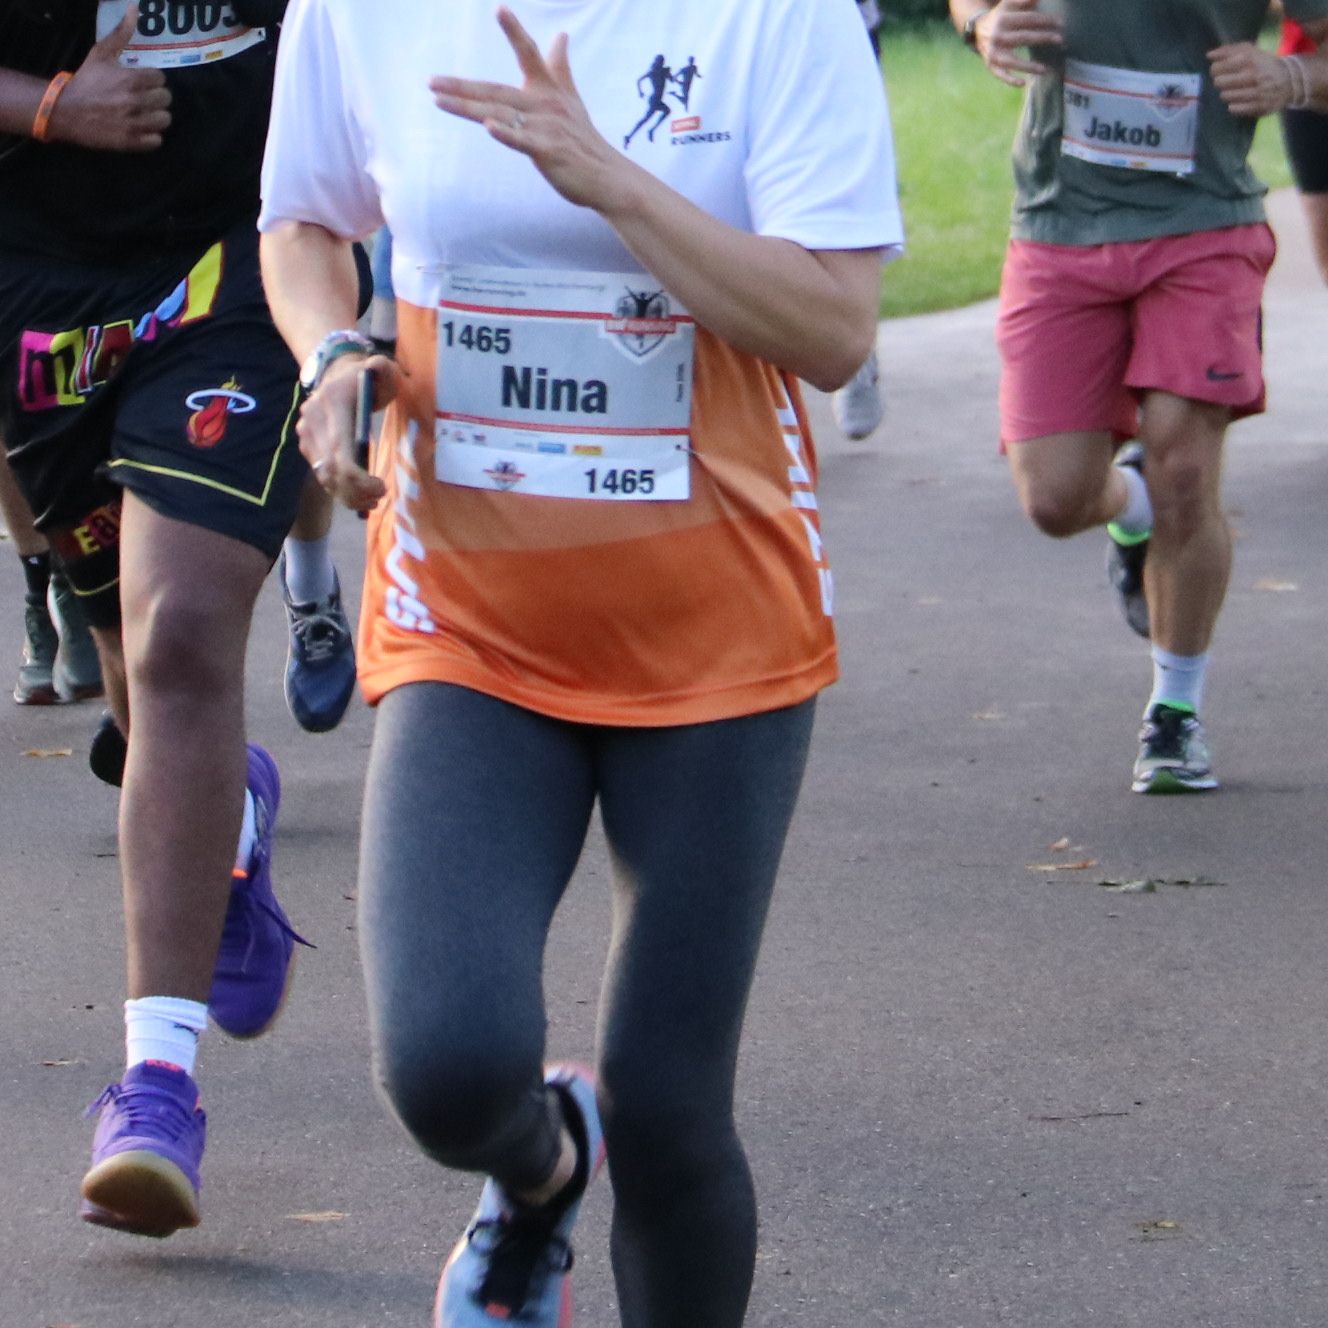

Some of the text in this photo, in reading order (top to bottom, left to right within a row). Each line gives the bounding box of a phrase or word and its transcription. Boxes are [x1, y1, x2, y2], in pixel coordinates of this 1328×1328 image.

[671, 132, 730, 146] RUNNERS
[1083, 117, 1161, 147] Jakob
[442, 321, 512, 355] 1465
[500, 365, 608, 415] Nina
[584, 468, 655, 495] 1465
